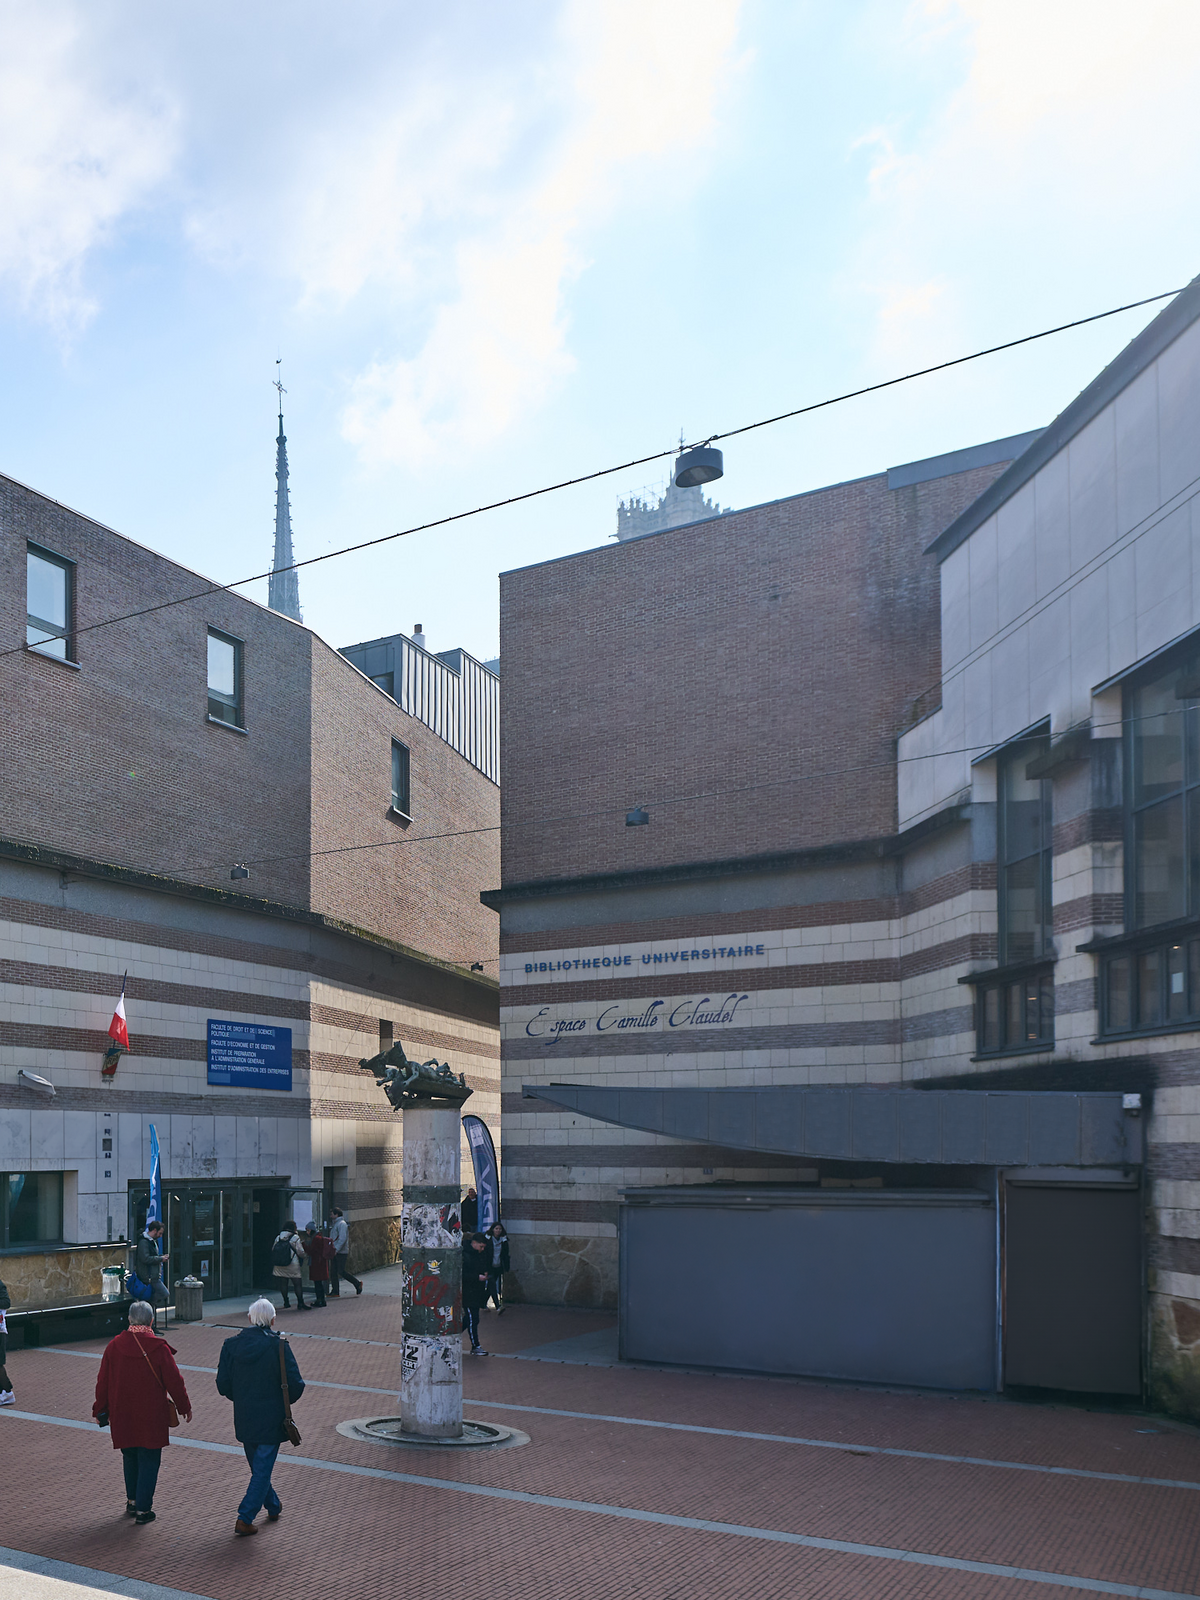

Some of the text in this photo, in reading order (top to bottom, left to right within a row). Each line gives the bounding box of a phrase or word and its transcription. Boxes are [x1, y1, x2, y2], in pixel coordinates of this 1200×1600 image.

[524, 944, 765, 973] BIBLIOTHEQUE UNIVERSITAIRE
[525, 993, 749, 1046] Espace Camille Claudel
